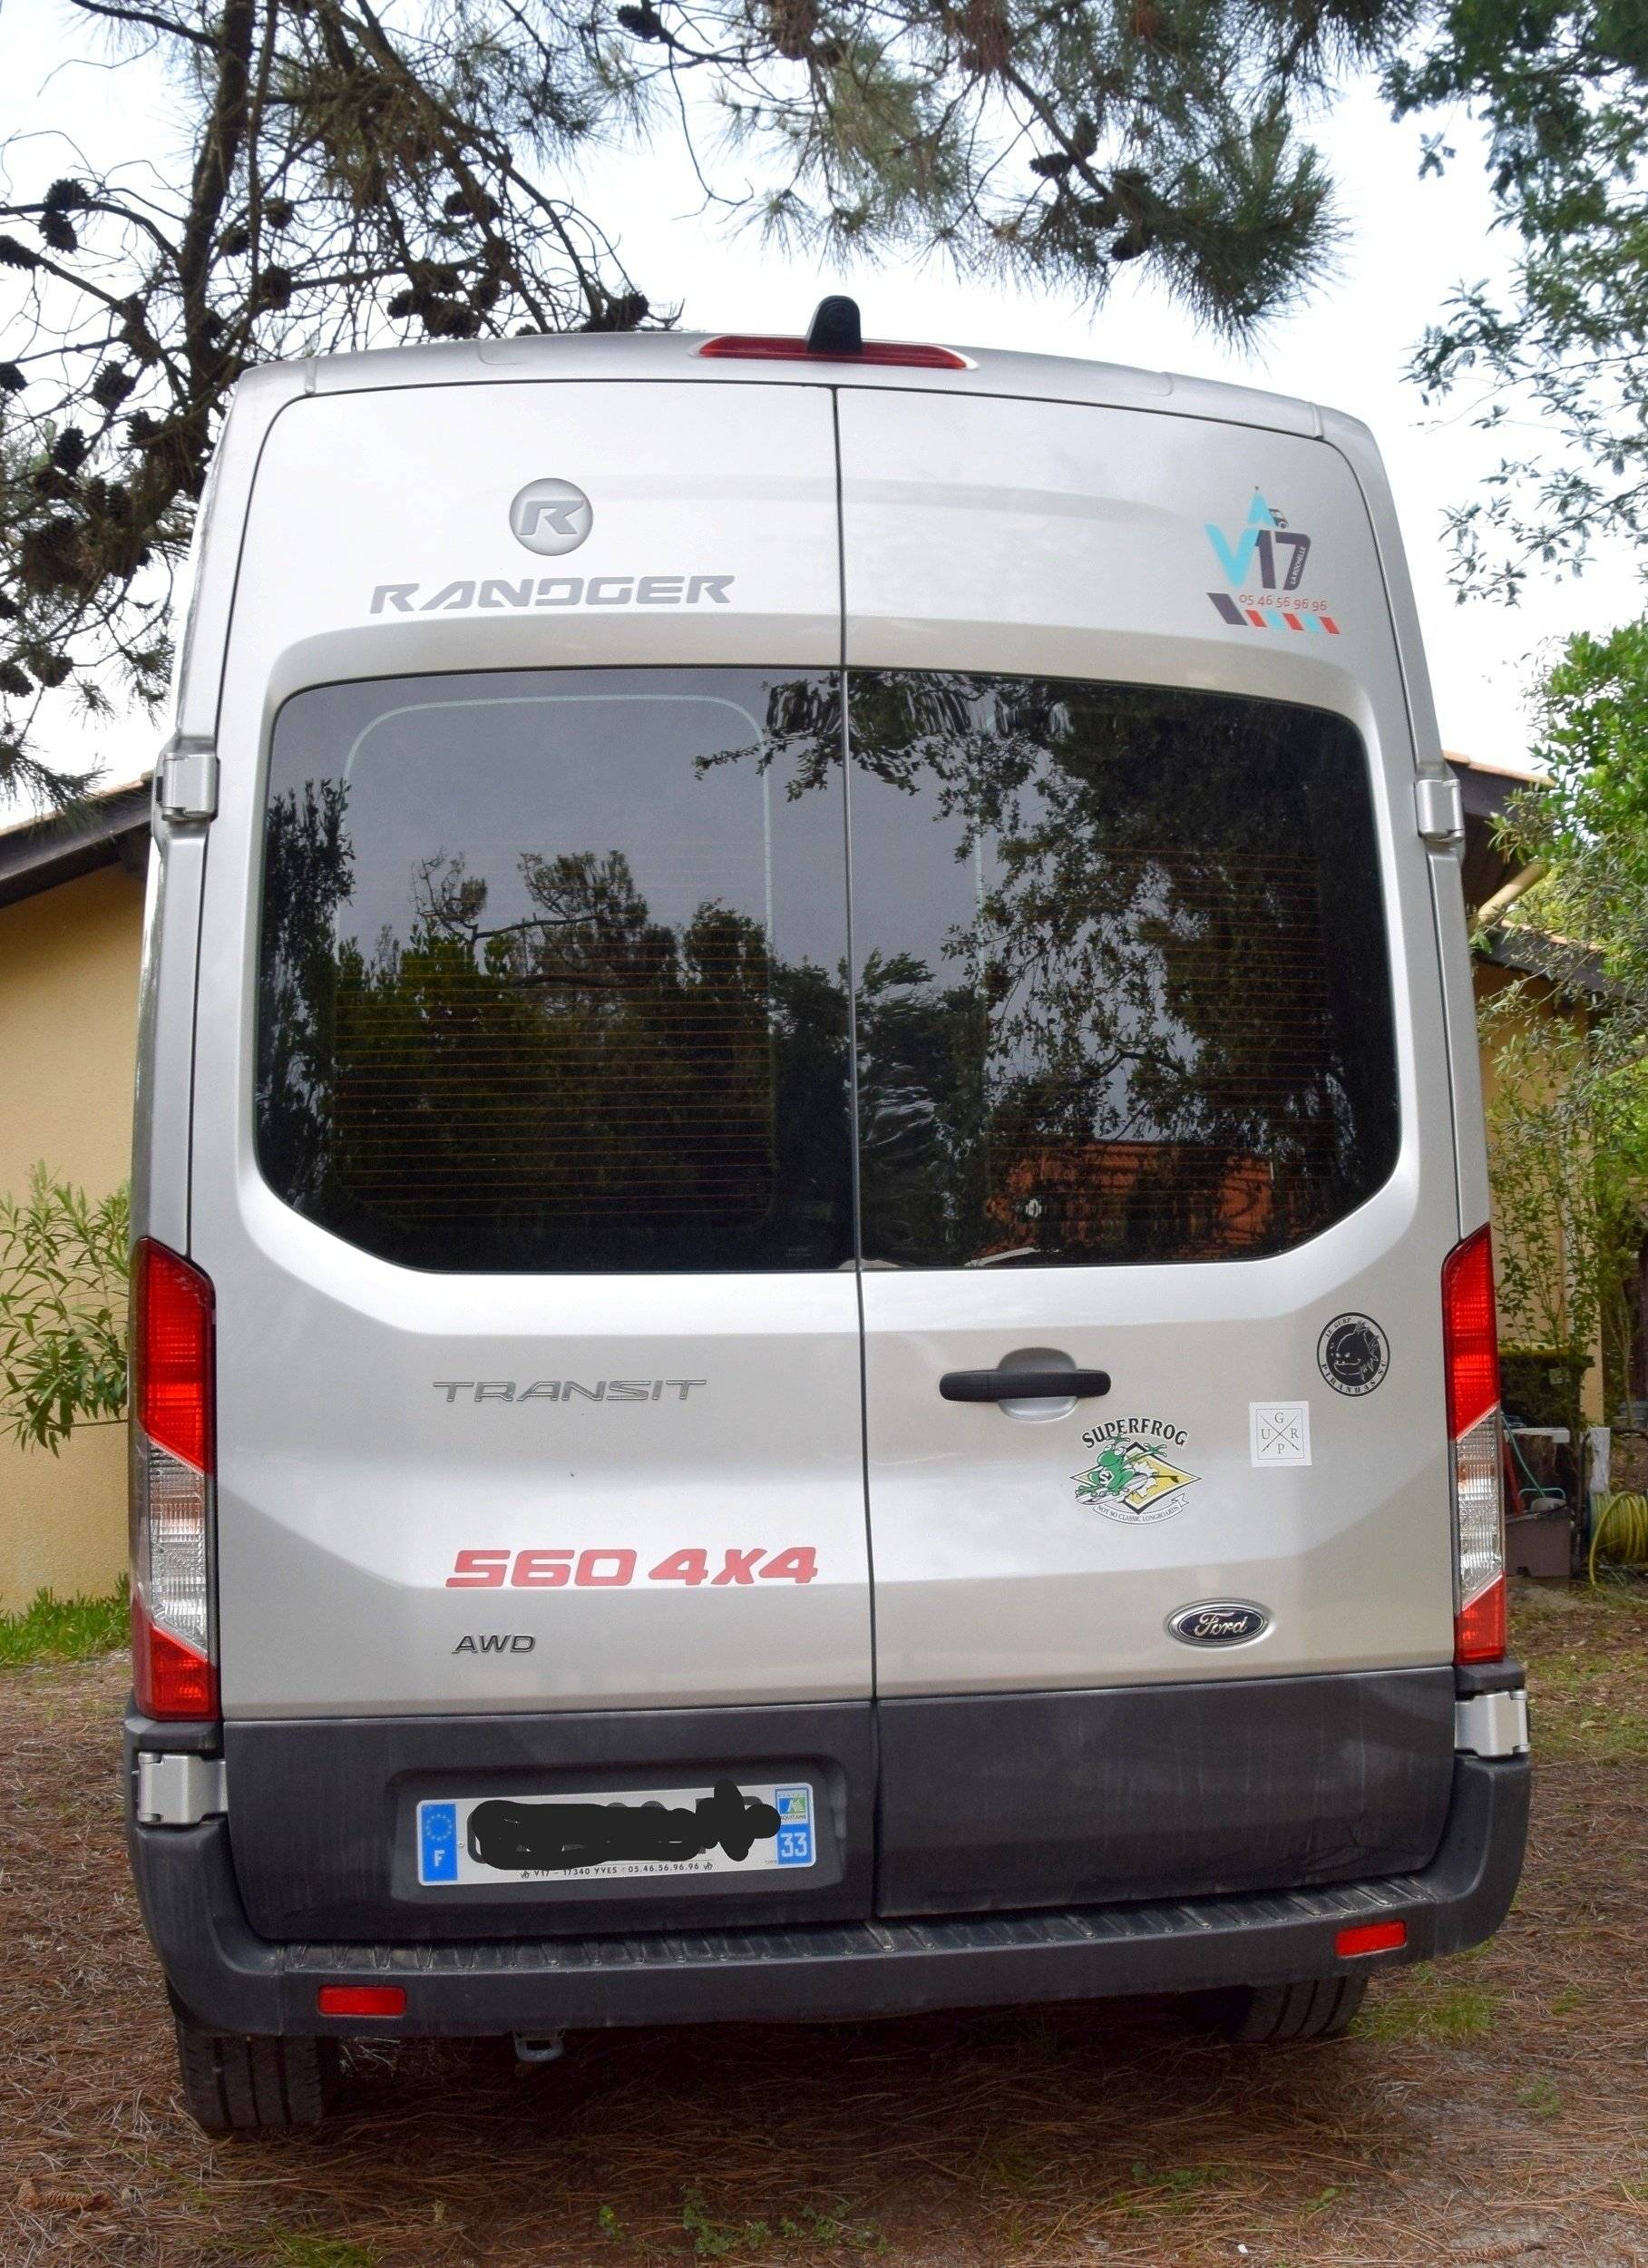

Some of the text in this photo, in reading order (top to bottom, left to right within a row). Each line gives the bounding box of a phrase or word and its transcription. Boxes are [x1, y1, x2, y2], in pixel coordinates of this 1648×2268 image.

[520, 500, 585, 535] R
[370, 575, 736, 614] RANDGER
[1239, 594, 1254, 606] 05
[1258, 595, 1273, 606] 46
[1276, 596, 1291, 608] 56
[1312, 601, 1328, 611] 96
[433, 1379, 707, 1403] TRANSIT
[1082, 1417, 1189, 1449] SUPERFROG
[1194, 1611, 1249, 1637] Ford
[451, 1634, 536, 1655] AWD
[780, 1833, 807, 1858] 33
[434, 1849, 445, 1867] F
[563, 1868, 590, 1876] 17340
[594, 1866, 618, 1874] YVES
[628, 1862, 700, 1873] 05.46.56.96.96
